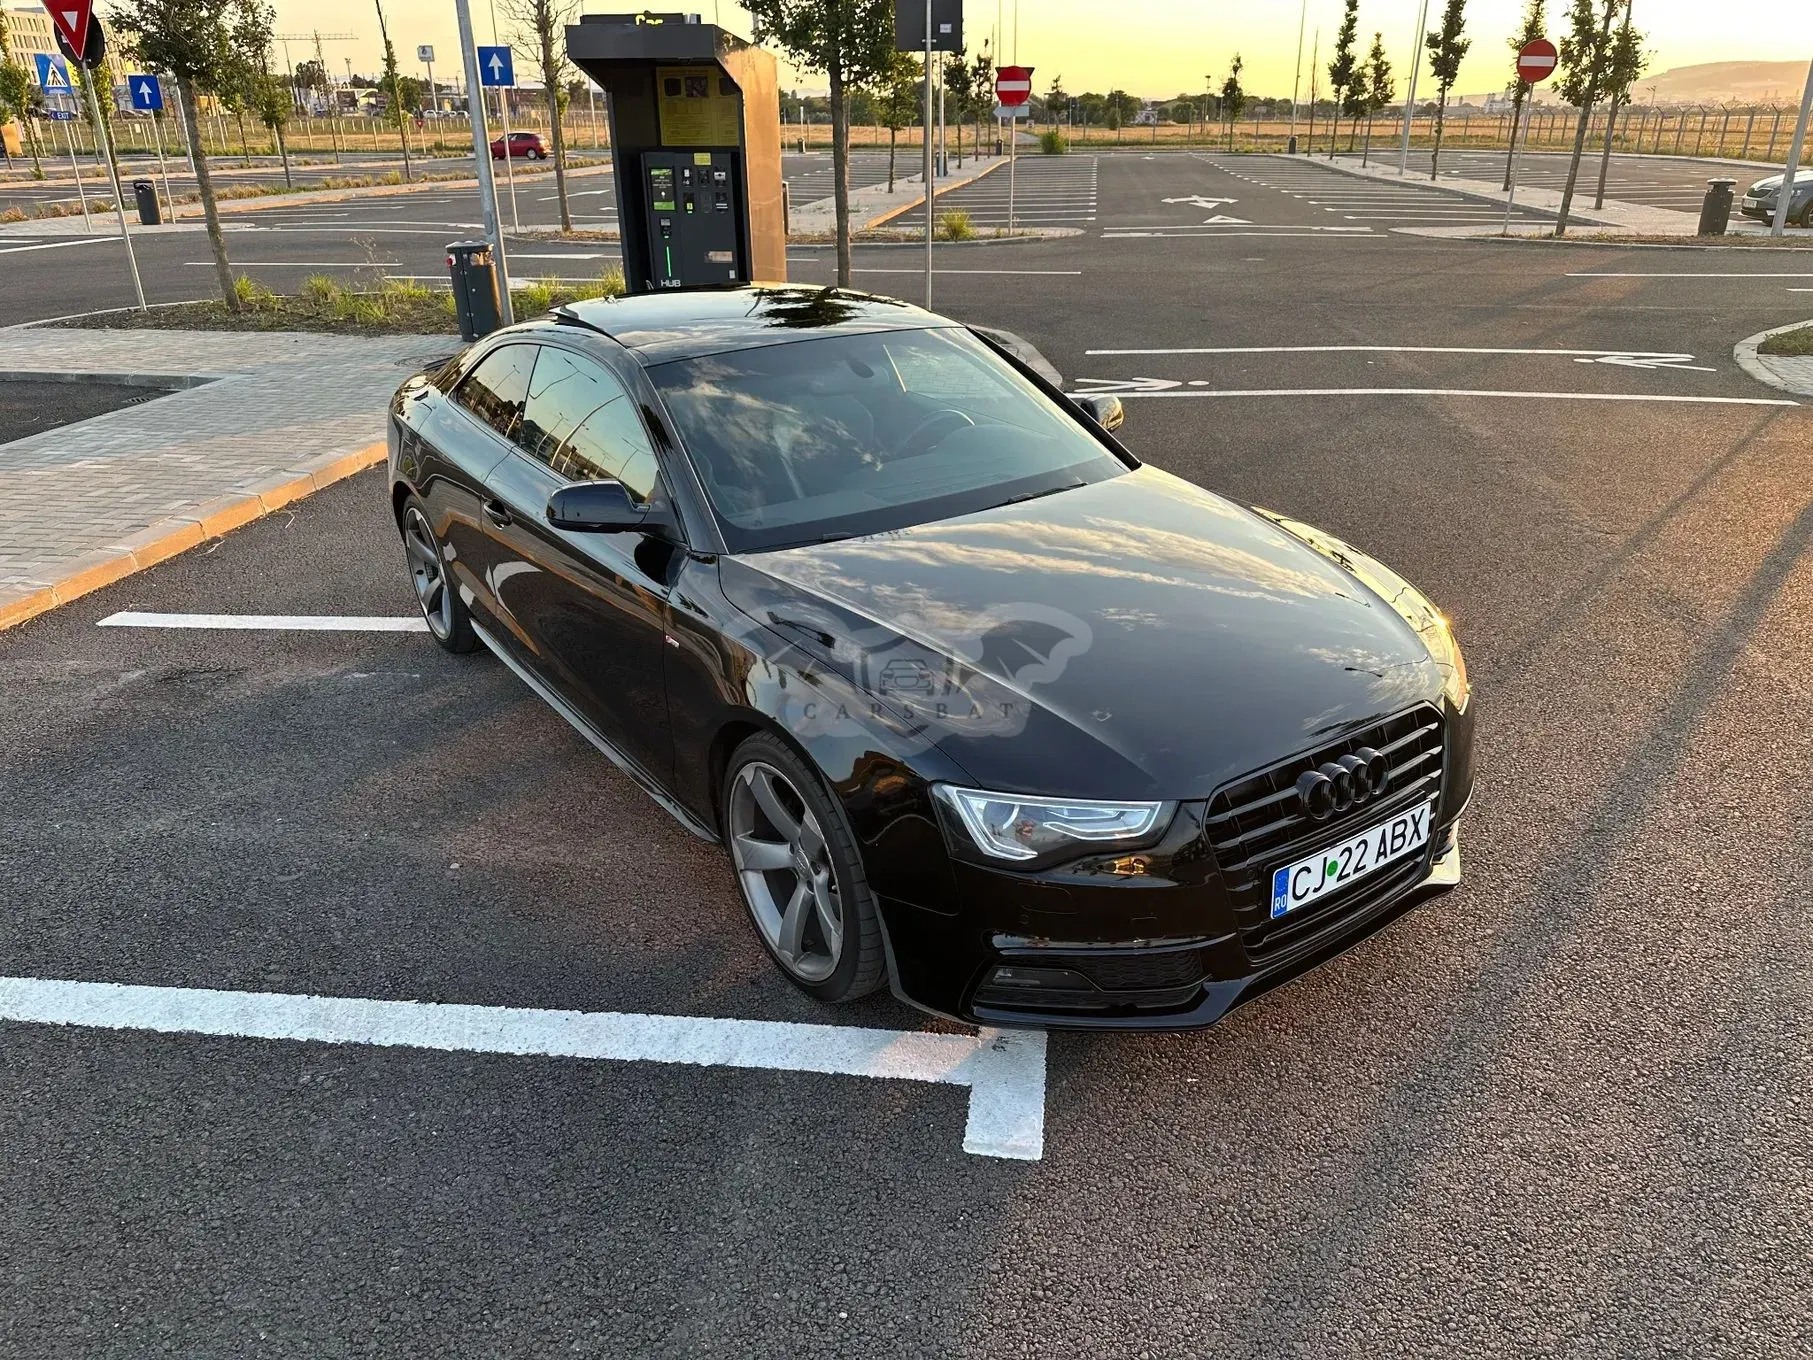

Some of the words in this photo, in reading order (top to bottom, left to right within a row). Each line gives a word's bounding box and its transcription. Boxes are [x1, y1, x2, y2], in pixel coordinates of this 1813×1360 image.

[660, 279, 681, 287] HUB
[1291, 856, 1328, 901] CJ
[1336, 839, 1369, 883] 22
[1375, 808, 1425, 864] ABX
[1275, 894, 1286, 911] RO
